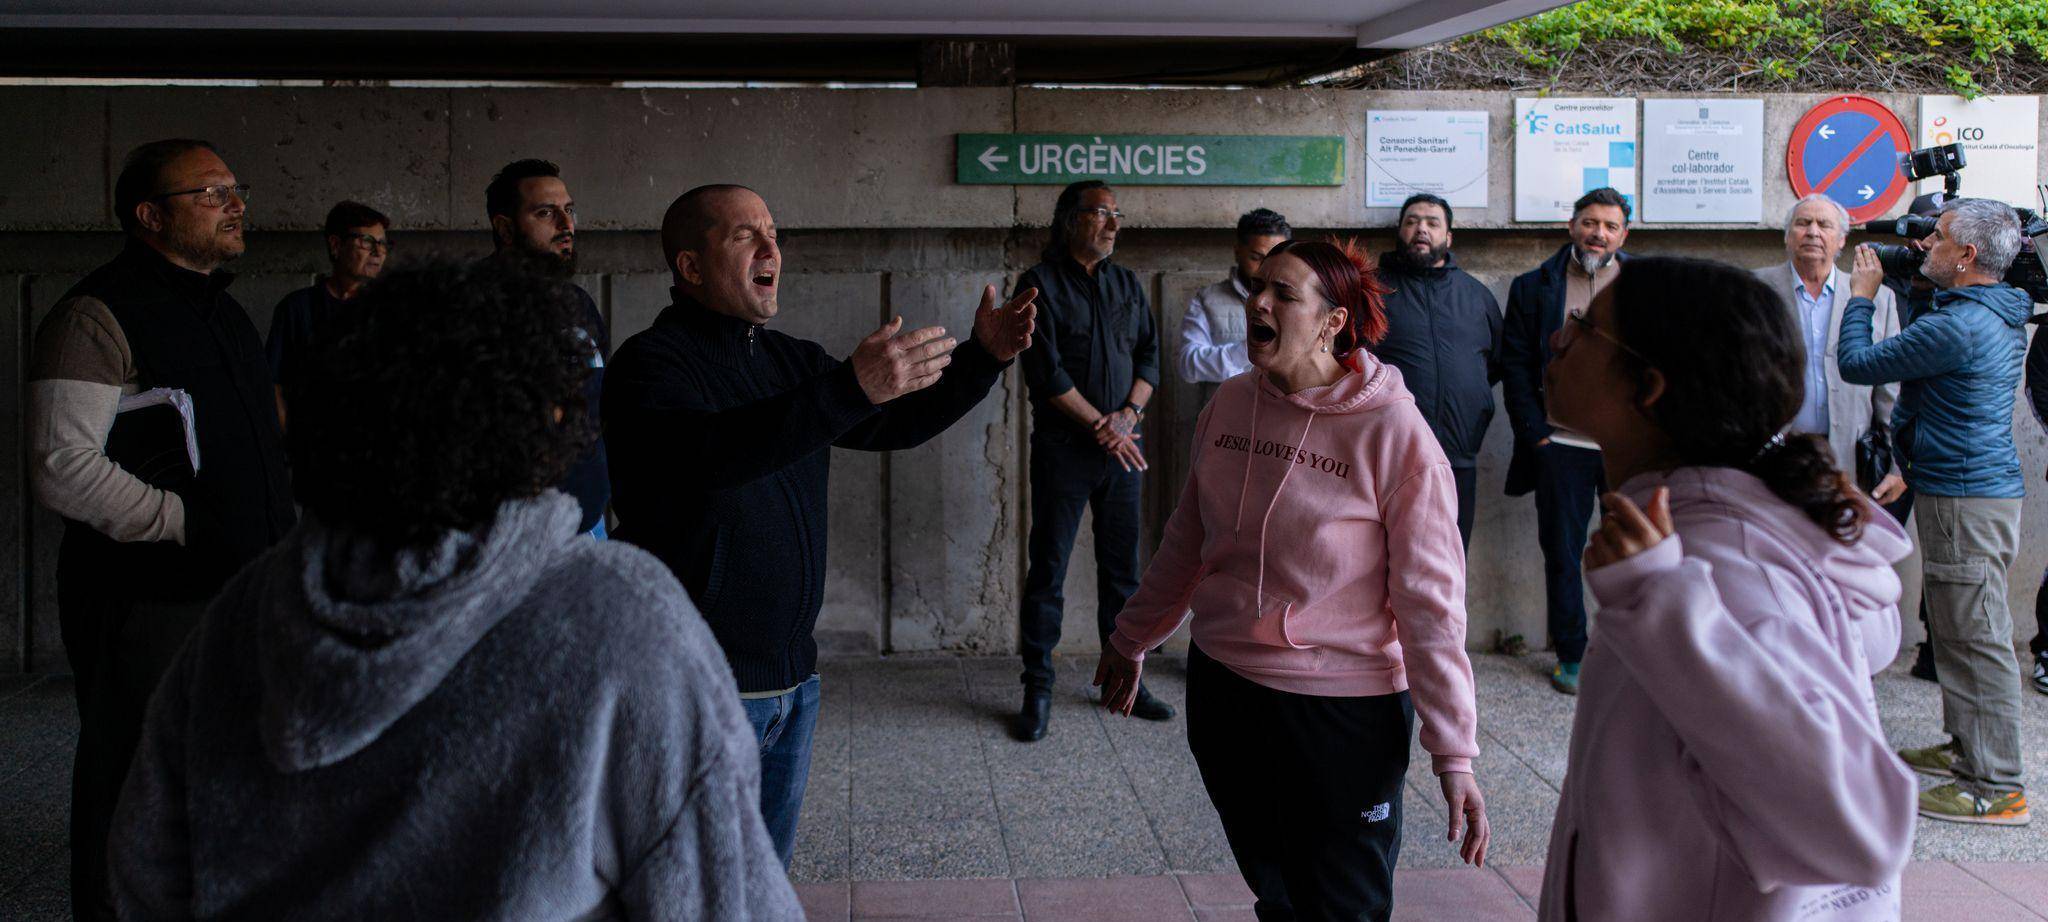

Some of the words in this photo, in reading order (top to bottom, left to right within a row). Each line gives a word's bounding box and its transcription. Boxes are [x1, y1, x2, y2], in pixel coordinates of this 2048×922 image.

[1554, 123, 1621, 135] CatSalut
[1957, 127, 1984, 141] ICO
[1379, 136, 1415, 144] Consorci
[1417, 136, 1448, 144] Sanitari
[1019, 136, 1207, 176] URGÈNCIES
[1688, 149, 1720, 160] Centre
[1254, 439, 1307, 465] LOVES
[1310, 453, 1350, 479] YOU
[1830, 888, 1870, 912] NEED
